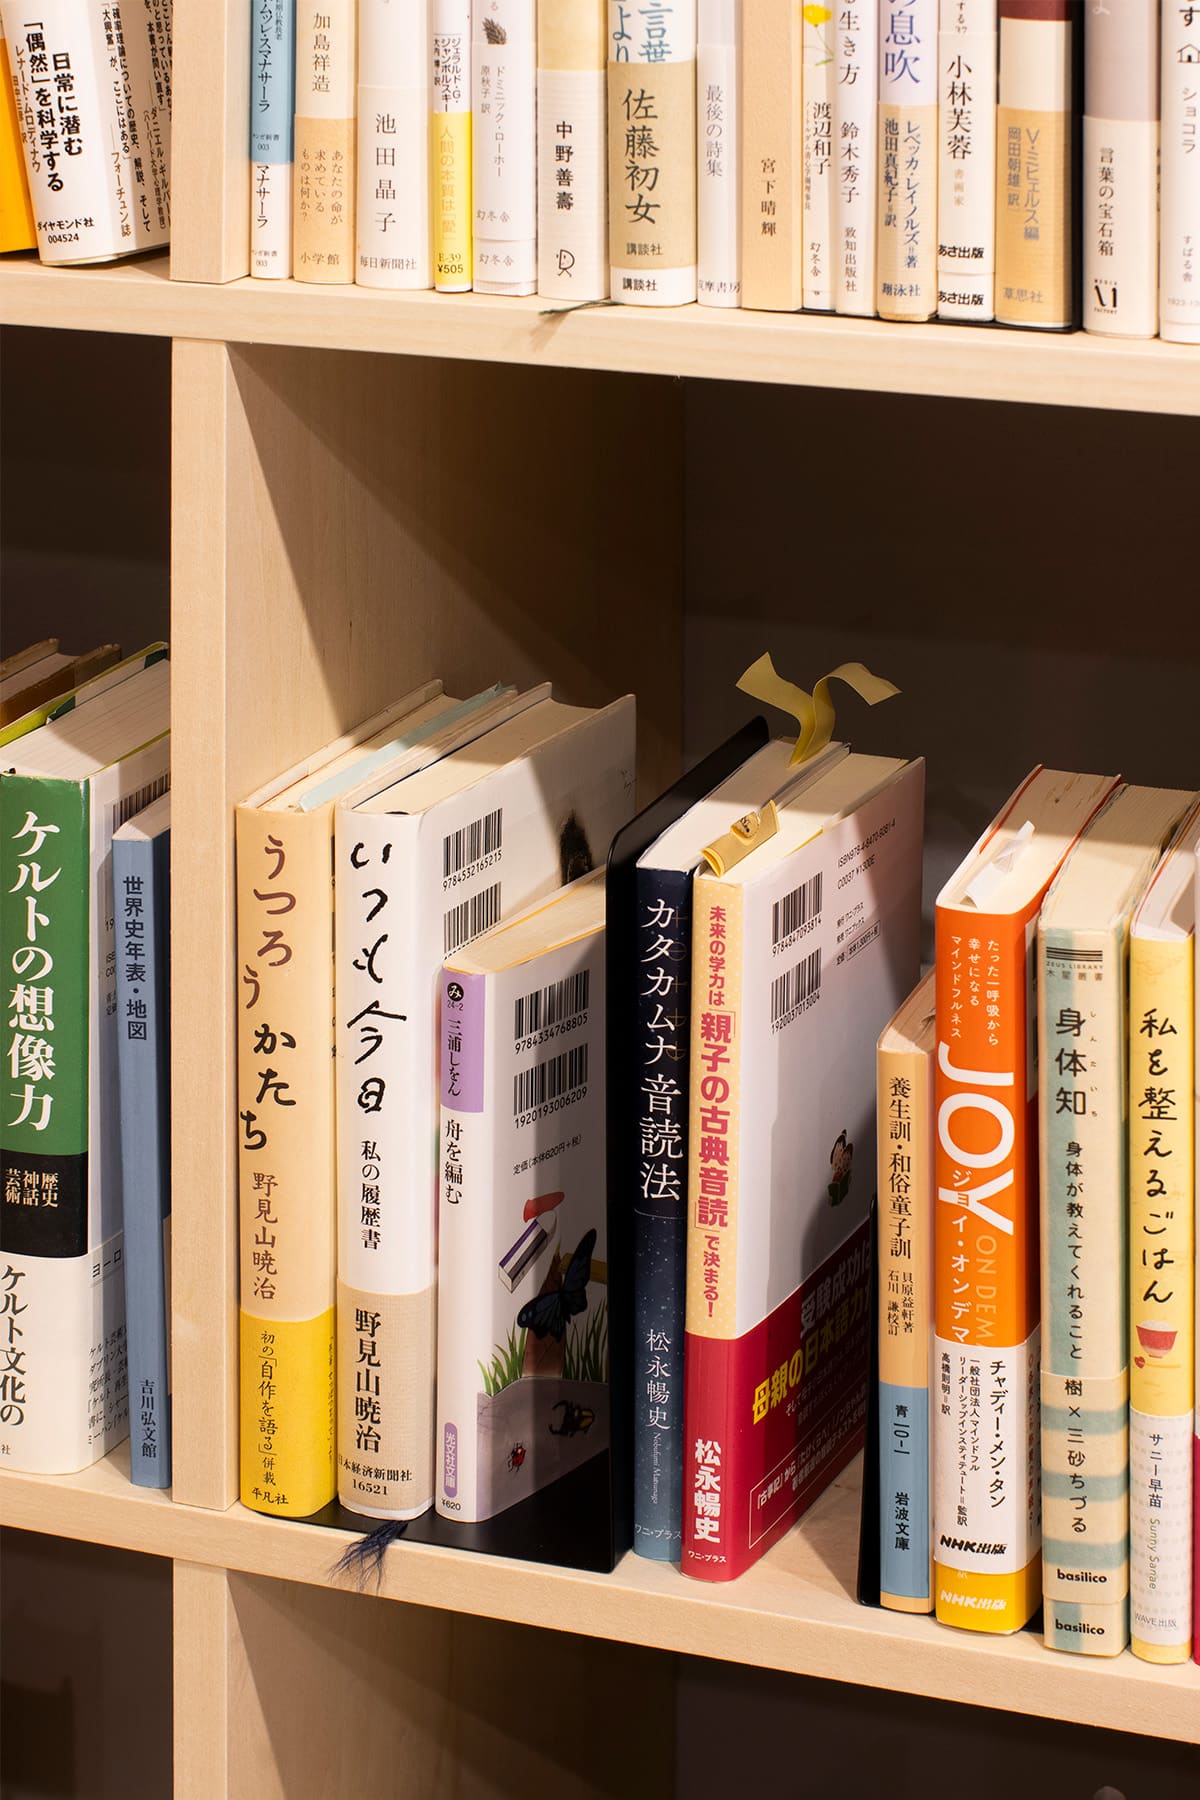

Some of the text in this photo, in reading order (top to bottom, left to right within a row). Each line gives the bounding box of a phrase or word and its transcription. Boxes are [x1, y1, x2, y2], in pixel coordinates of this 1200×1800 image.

[258, 0, 273, 113] ムッレ・スマナサーラ
[312, 12, 331, 92] 加島祥造
[838, 0, 860, 85] 生き方
[884, 0, 921, 84] 息吹
[24, 22, 64, 192] 「偶然」を科学する
[52, 52, 83, 156] 日常に潜む
[706, 85, 724, 177] 最後の詩集
[947, 55, 972, 160] 小林芙蓉
[1182, 88, 1197, 154] ショコラ
[314, 149, 327, 213] 求めている
[330, 150, 344, 225] あなたの命が
[375, 113, 397, 233] 池田晶子
[622, 88, 661, 224] 佐藤初女
[841, 121, 860, 204] 鈴木秀子
[256, 165, 270, 228] マナサーラ
[761, 158, 776, 237] 宮下晴輝
[1098, 147, 1114, 257] 言葉の宝石箱
[47, 232, 79, 243] 004524
[300, 252, 340, 265] 小学館
[360, 255, 417, 271] 毎日新聞社
[437, 264, 464, 274] ¥505
[626, 243, 663, 256] 講談社
[937, 244, 984, 259] あさ出版
[622, 277, 657, 291] 講談社
[937, 291, 984, 306] あさ出版
[442, 850, 502, 892] 9784532165215
[8, 811, 61, 1131] ケルトの想像力
[123, 876, 147, 1040] 世界史年表・地図
[951, 936, 963, 1038] マインドフルネス
[968, 938, 981, 1006] 幸せになる
[986, 940, 1000, 1046] たった一呼吸から
[447, 1019, 463, 1097] 三浦しをん
[515, 1011, 588, 1055] 9784334768805
[640, 898, 683, 1201] カタカムナ音読法
[1055, 1008, 1087, 1116] 身体知
[514, 1086, 588, 1130] 1920193006209
[938, 1041, 1014, 1236] JOY
[361, 1140, 382, 1250] 私の履歴書
[445, 1119, 464, 1205] 舟を編む
[889, 1077, 911, 1260] 養生訓・和俗童子訓
[1138, 1008, 1178, 1304] 私を整えるごはん
[252, 1172, 278, 1300] 野見山暁治
[1066, 1141, 1085, 1360] 身体が教えてくれること
[0, 1264, 29, 1426] ケルト文化の
[975, 1285, 997, 1346] DEM
[140, 1379, 157, 1459] 吉川弘文館
[355, 1308, 382, 1453] 野見山暁治
[646, 1328, 672, 1430] 松永暢史
[251, 1487, 289, 1505] 平凡社
[352, 1479, 388, 1495] 16521
[694, 1439, 722, 1544] 松永暢史
[1148, 1433, 1163, 1508] サニー早苗
[894, 1492, 910, 1551] 岩波文庫
[940, 1534, 1007, 1555] NHK出版
[1149, 1518, 1160, 1590] Sunny Sanae
[940, 1590, 1007, 1611] NHK出版
[1057, 1569, 1107, 1584] basilico
[1055, 1619, 1105, 1636] basilico
